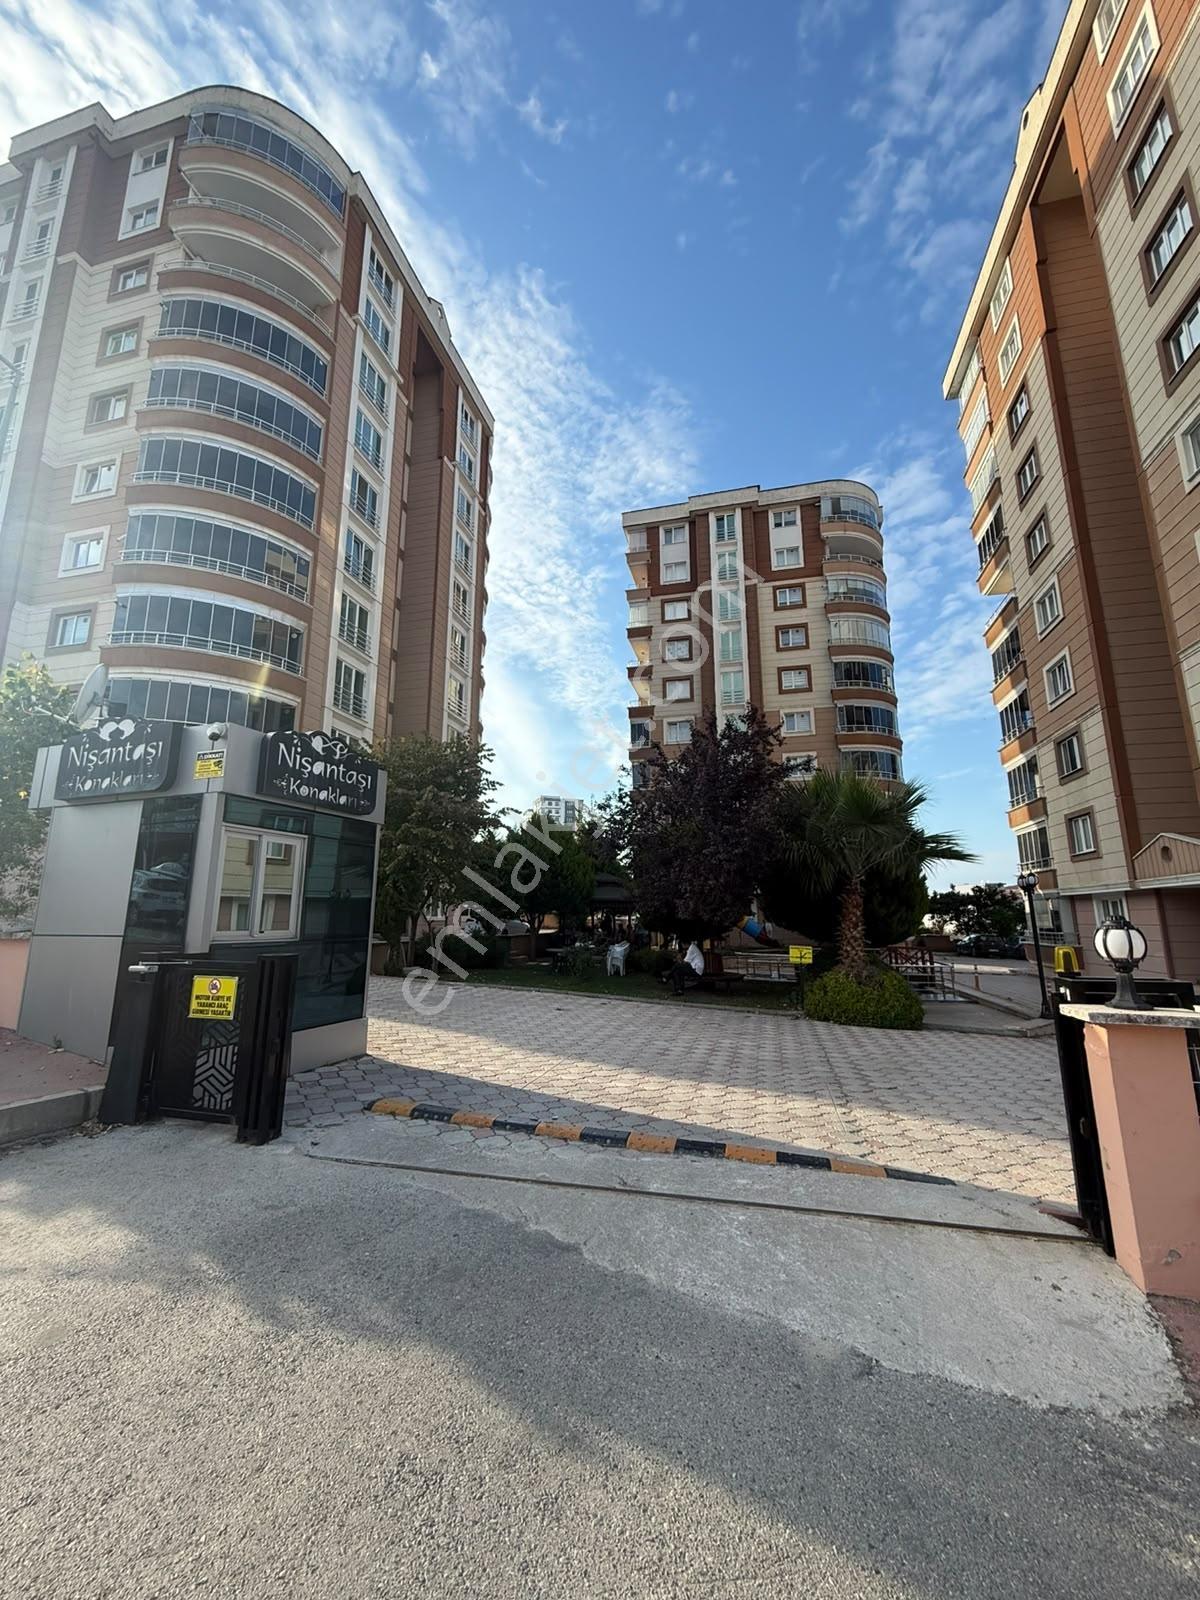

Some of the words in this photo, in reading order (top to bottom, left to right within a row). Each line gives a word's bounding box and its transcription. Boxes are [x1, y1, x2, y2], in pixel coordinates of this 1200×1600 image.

[67, 741, 163, 772] Nişantaşı
[278, 742, 372, 793] Nişantaşı
[75, 770, 144, 792] Konakları
[289, 777, 358, 808] Konakları
